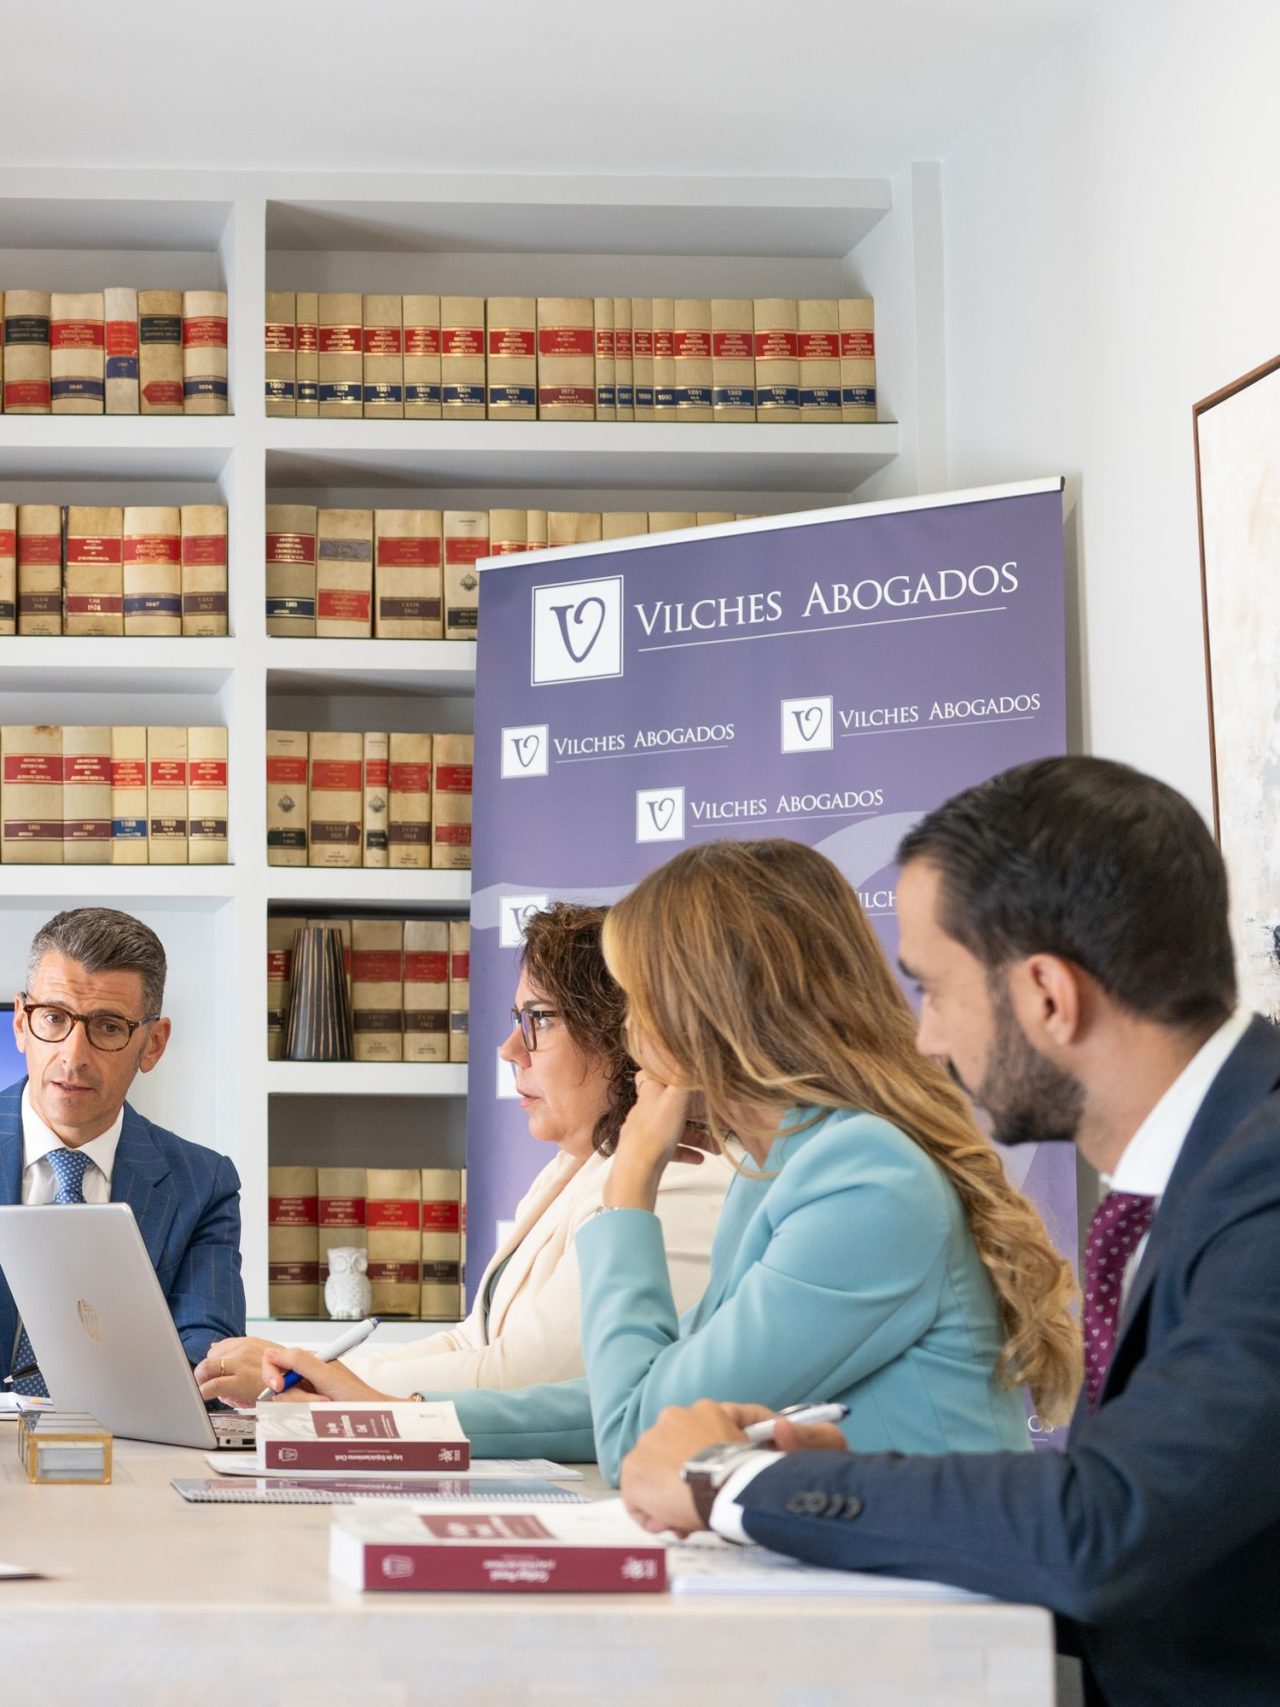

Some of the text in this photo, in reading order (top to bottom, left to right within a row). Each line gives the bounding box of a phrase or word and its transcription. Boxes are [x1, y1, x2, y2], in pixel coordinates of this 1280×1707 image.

[634, 561, 1019, 636] VILCHES ABOGADOS
[838, 693, 1041, 730] VILCHES ABOGADOS
[554, 723, 735, 757] VILCHES ABOGADOS
[690, 788, 884, 821] VILCHES ABOGADOS
[855, 891, 897, 908] ILCH
